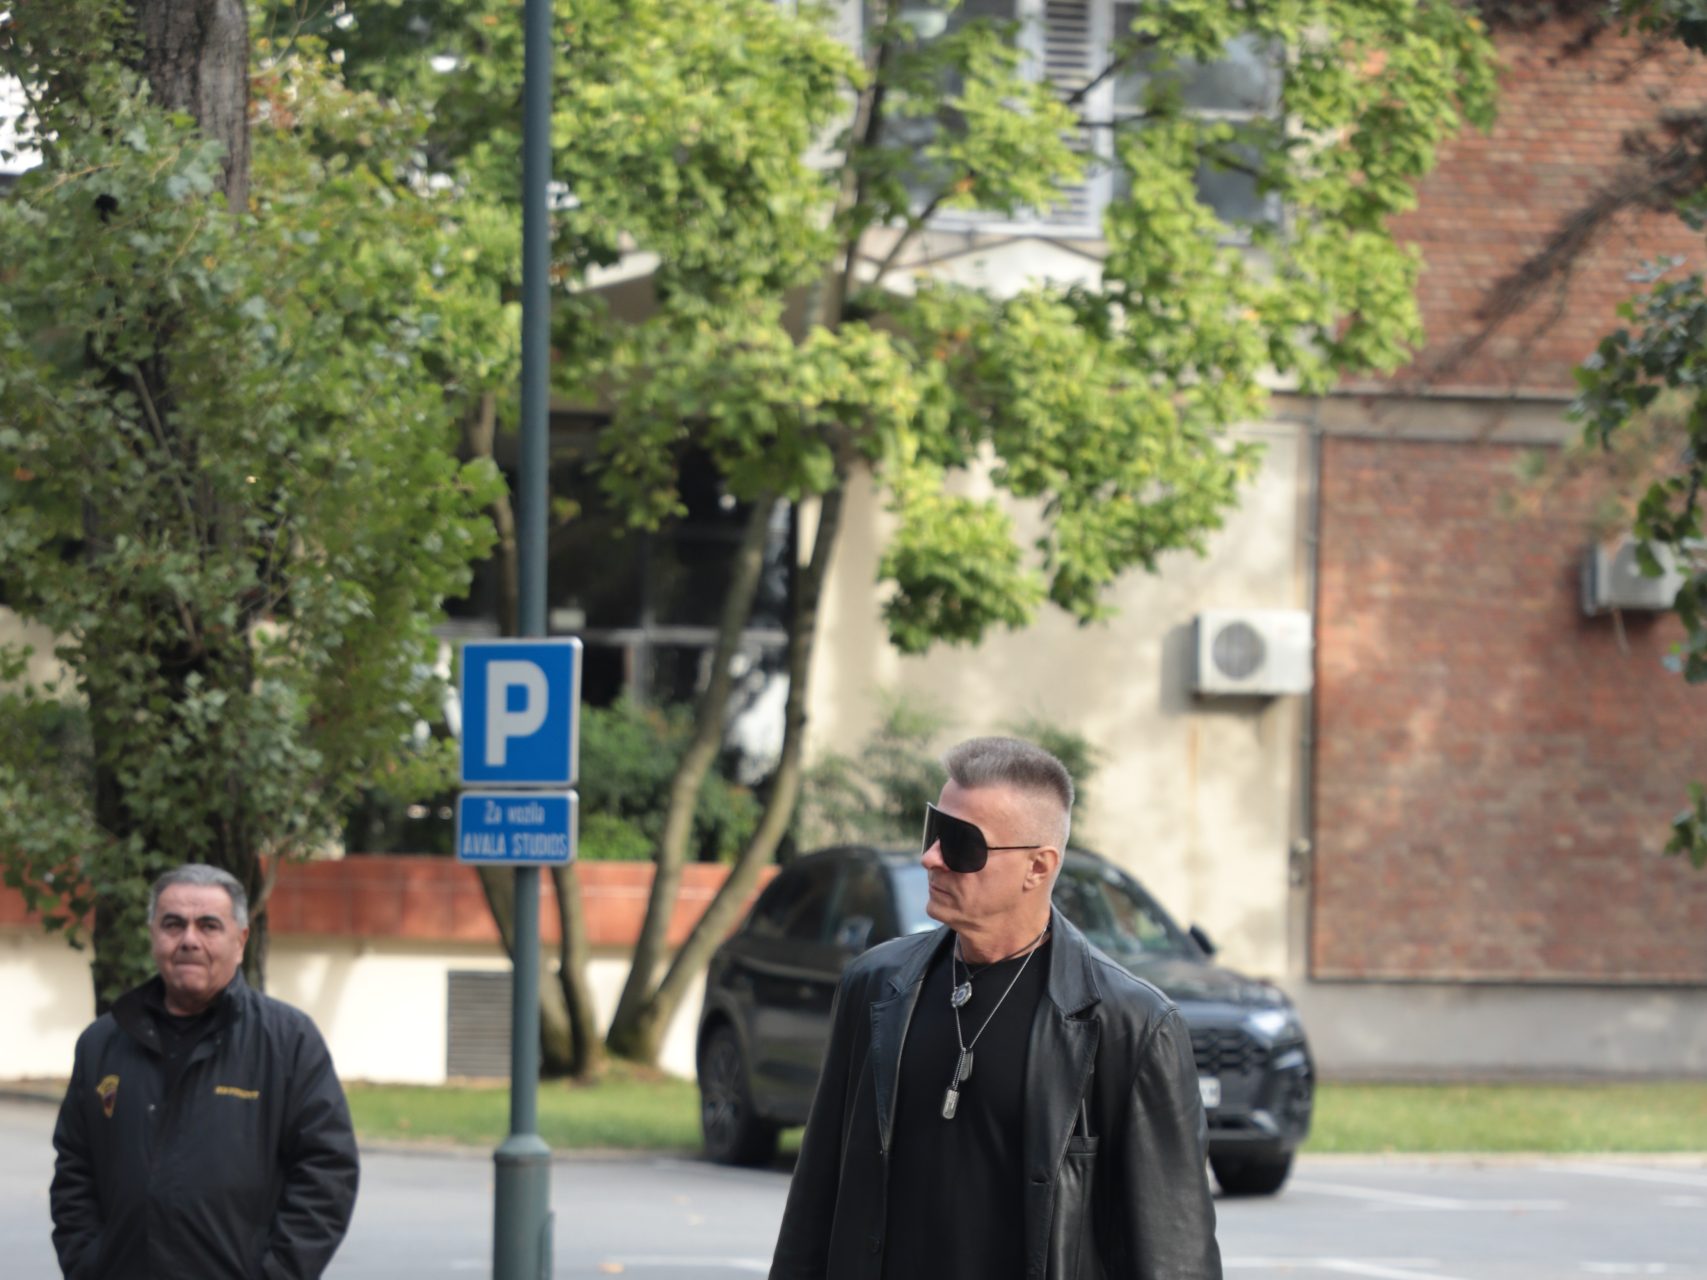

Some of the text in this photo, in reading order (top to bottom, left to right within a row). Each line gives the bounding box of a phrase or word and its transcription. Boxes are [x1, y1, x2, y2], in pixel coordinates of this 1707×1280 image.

[485, 660, 549, 766] P
[484, 801, 544, 824] Za vozila
[463, 832, 567, 856] AVALA STUDIOS
